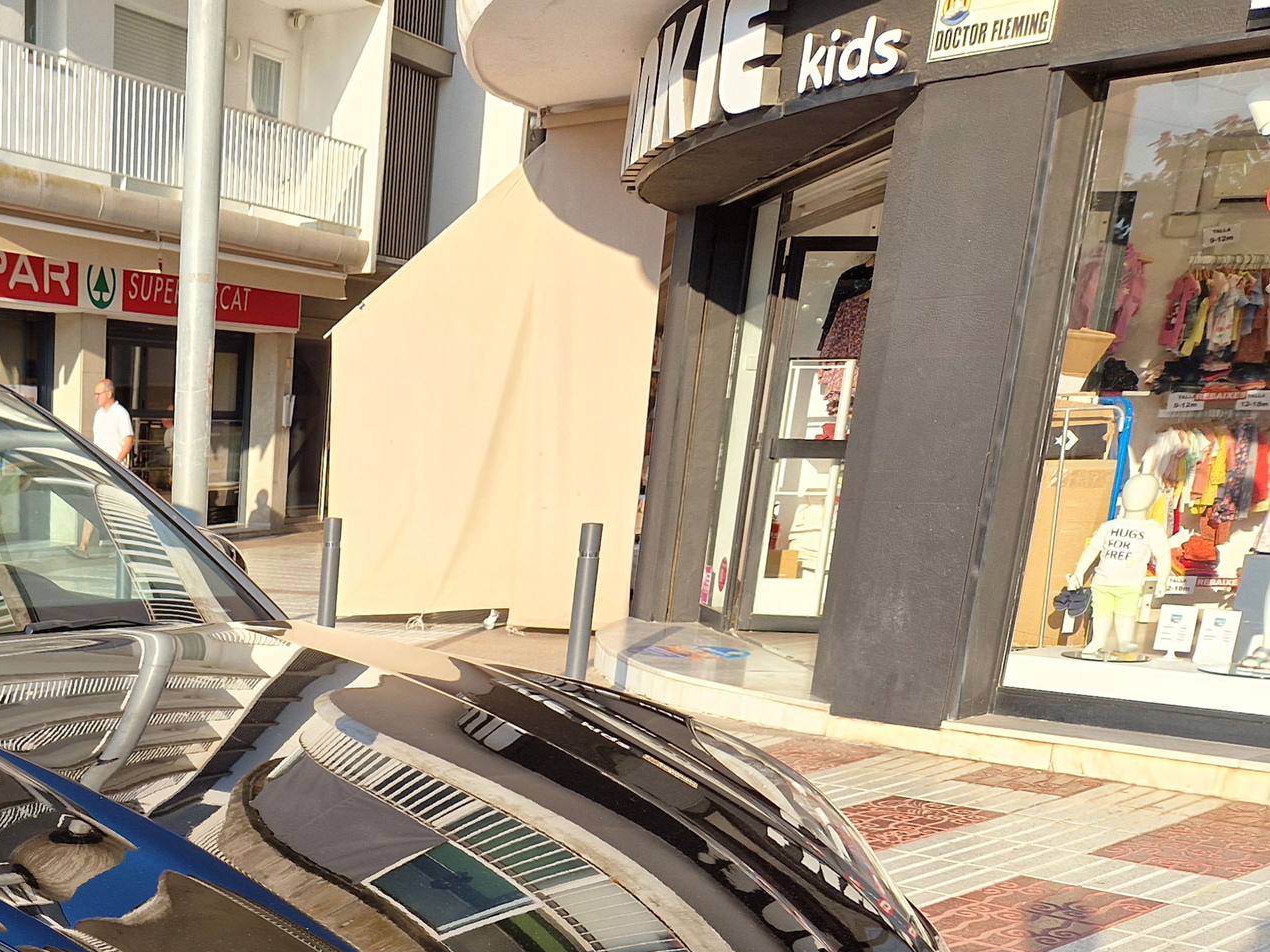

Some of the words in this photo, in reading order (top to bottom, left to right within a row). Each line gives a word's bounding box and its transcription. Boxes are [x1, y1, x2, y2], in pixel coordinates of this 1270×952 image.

[933, 22, 989, 52] DOCTOR
[990, 11, 1050, 42] FLEMING
[797, 15, 908, 94] kids
[1210, 235, 1234, 243] 9-12m
[128, 273, 252, 312] SUPECAT
[1195, 392, 1247, 400] REBAIXES
[1110, 528, 1145, 540] HUGS
[1108, 540, 1131, 549] FOR
[1197, 578, 1239, 586] REBAIXE
